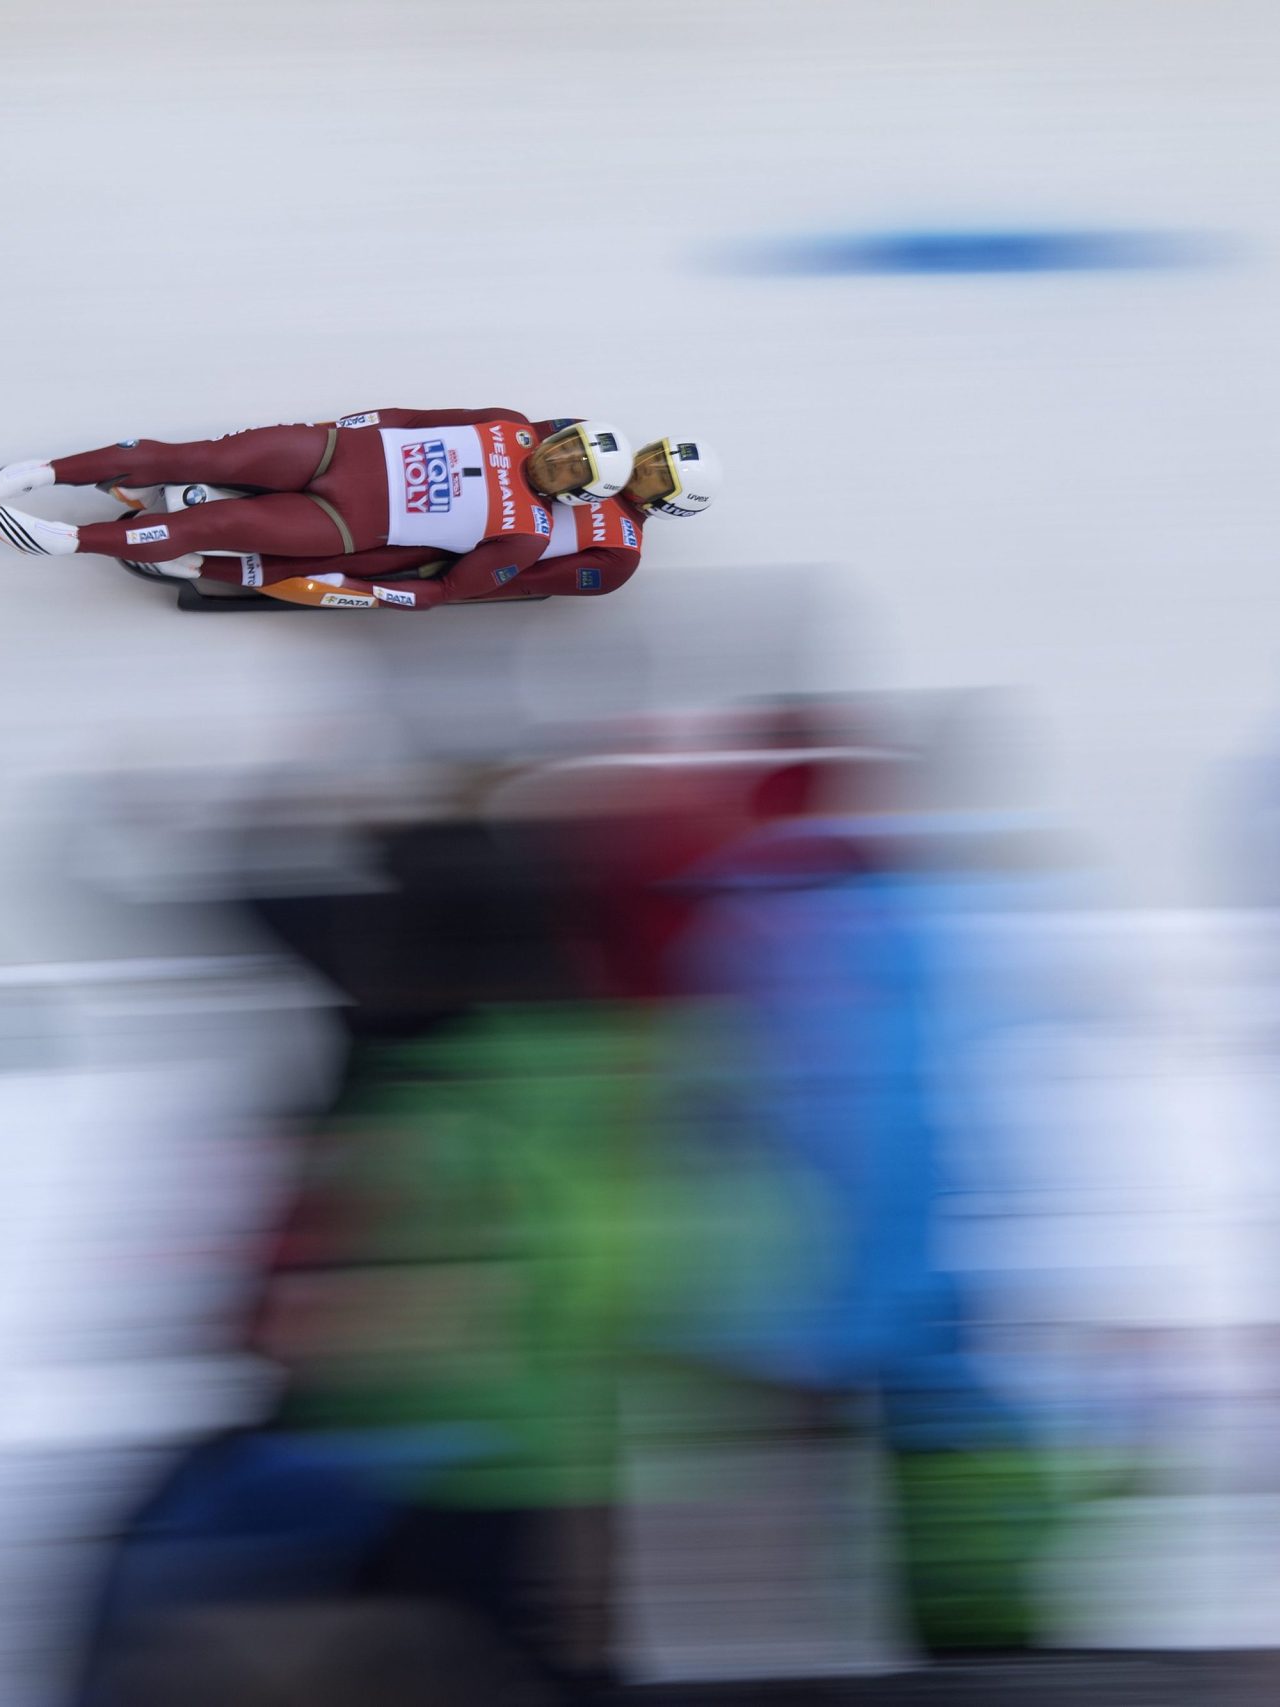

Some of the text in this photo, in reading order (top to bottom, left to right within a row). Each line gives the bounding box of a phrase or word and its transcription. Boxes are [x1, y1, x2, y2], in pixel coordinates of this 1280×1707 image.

[402, 443, 427, 513] MOLY
[423, 440, 450, 512] LIQUI
[536, 507, 549, 534] DKB
[623, 519, 637, 546] DKB
[139, 529, 167, 543] PATA
[337, 598, 369, 608] PATA
[385, 592, 413, 606] PATA
